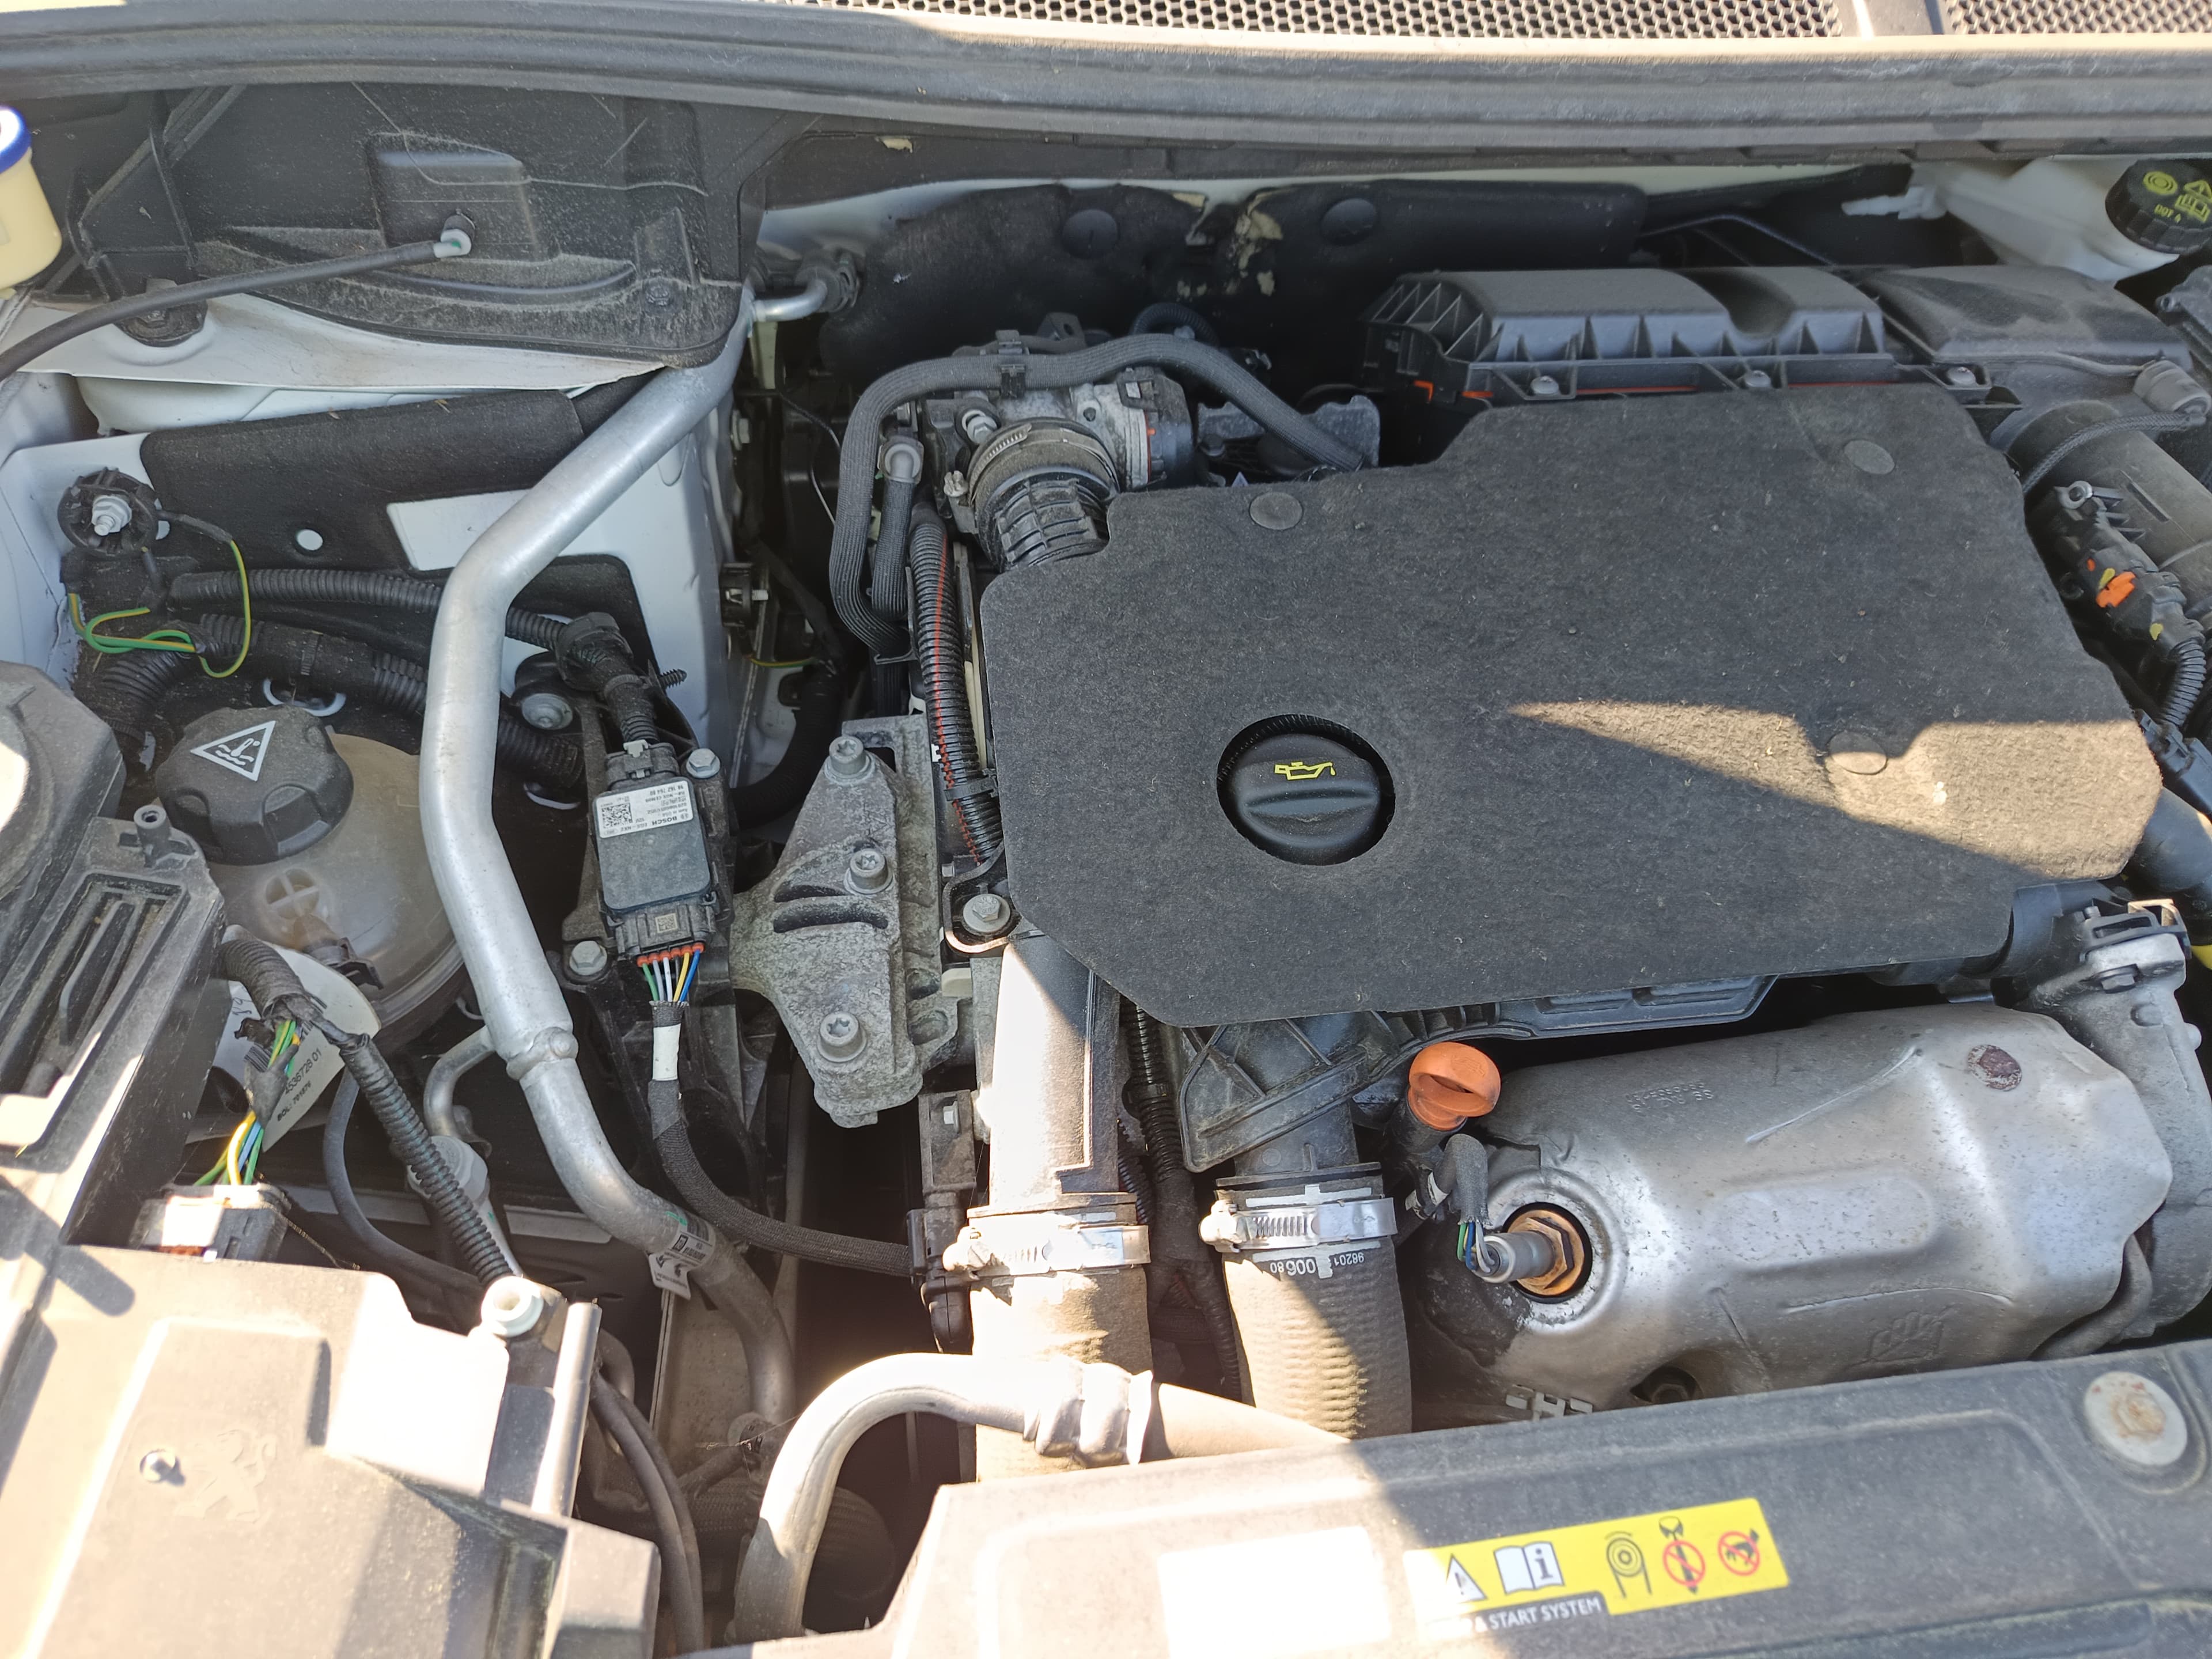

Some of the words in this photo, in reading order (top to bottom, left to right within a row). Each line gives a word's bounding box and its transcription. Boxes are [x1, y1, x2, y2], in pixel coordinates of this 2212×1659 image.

[651, 816, 677, 825] BOSCH
[312, 1048, 321, 1062] 01
[1334, 1252, 1365, 1266] 98201
[1488, 1606, 1537, 1630] START
[1541, 1596, 1603, 1622] SYSTEM
